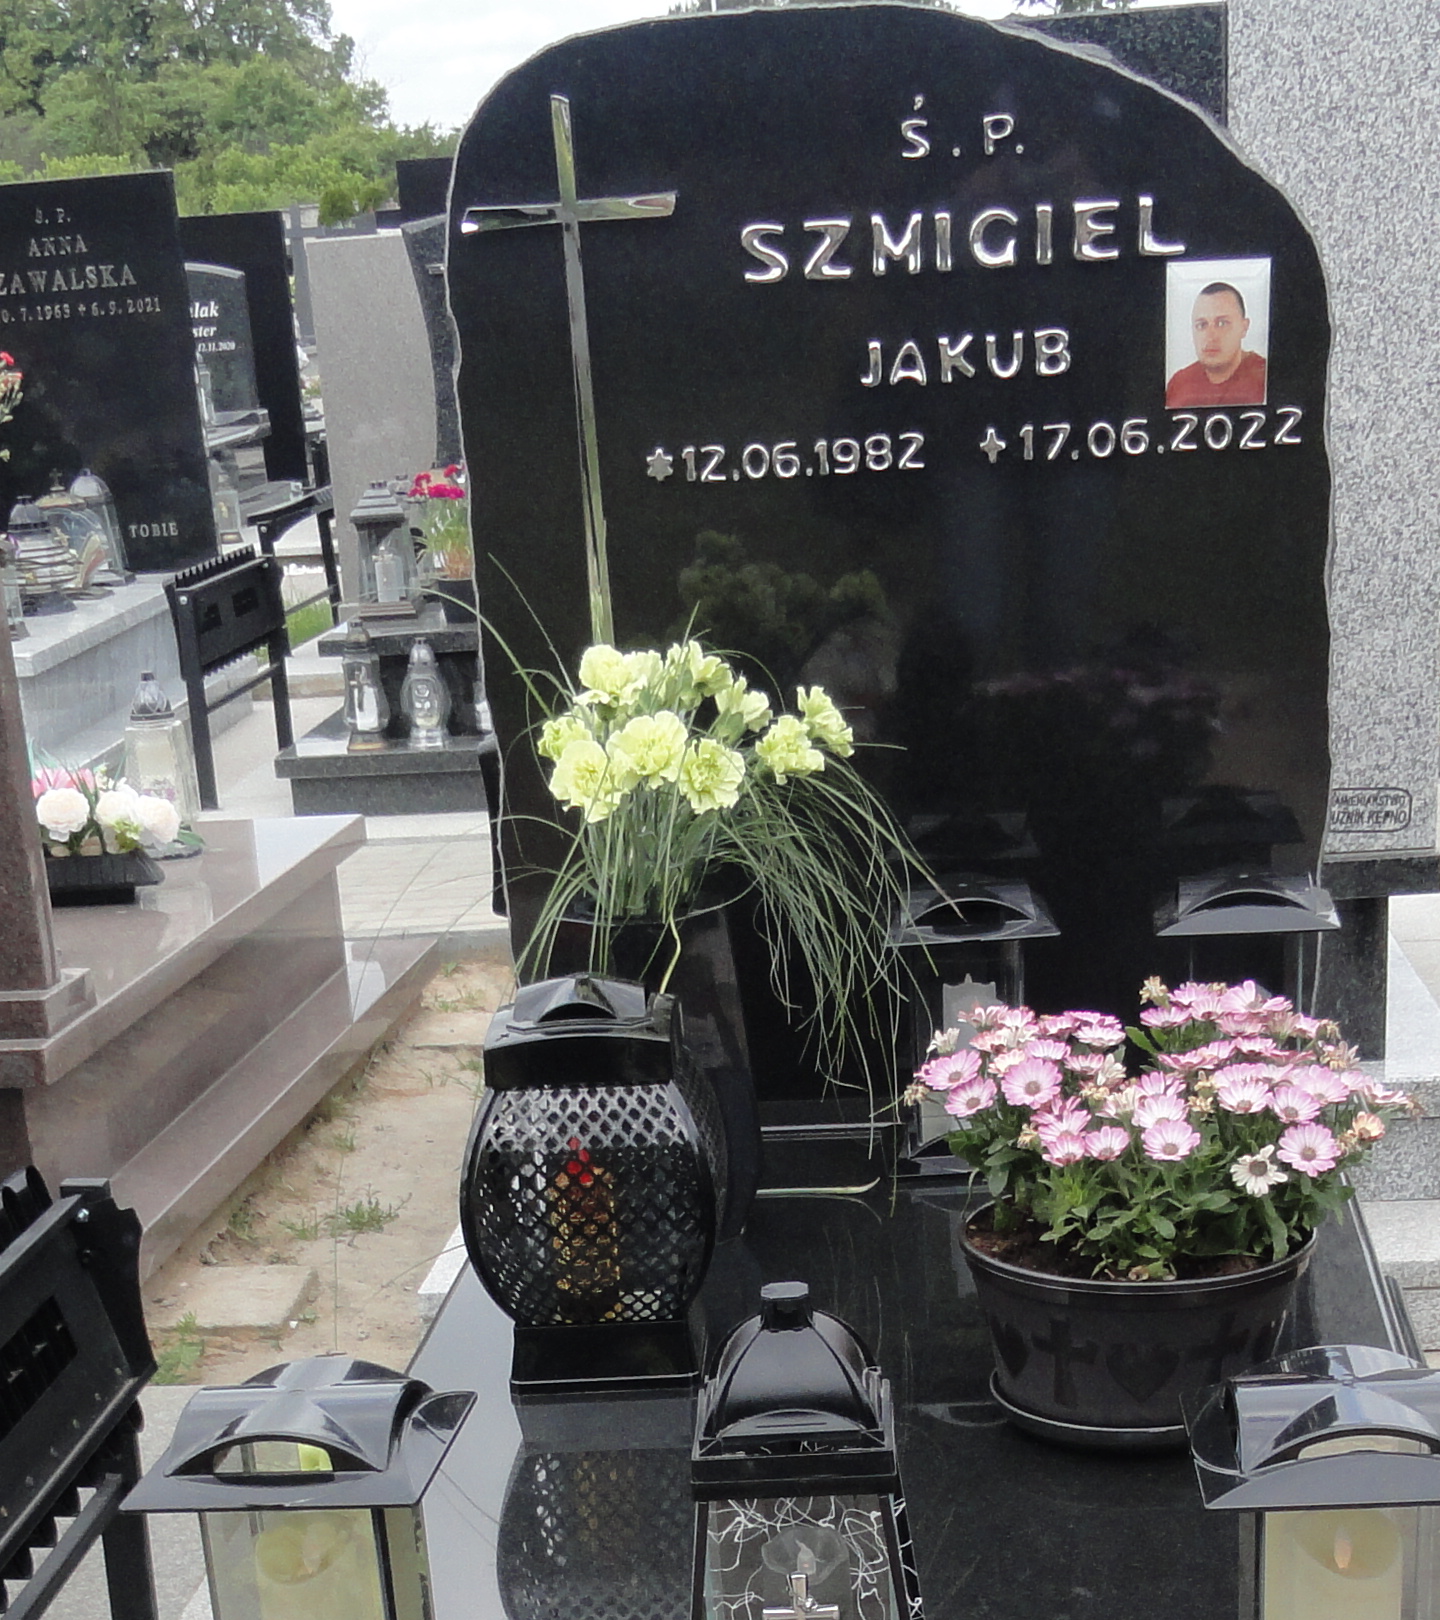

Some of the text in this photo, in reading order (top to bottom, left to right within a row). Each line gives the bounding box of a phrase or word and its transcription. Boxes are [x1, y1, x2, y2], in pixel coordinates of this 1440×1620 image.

[983, 113, 1026, 156] P.
[28, 234, 88, 257] ANNA
[740, 195, 1185, 285] SZMIGIEL
[192, 325, 218, 338] ster
[859, 327, 1072, 387] JAKUB
[680, 406, 1304, 485] 12.06.1982 17.06.2022
[128, 521, 180, 539] TOBIE
